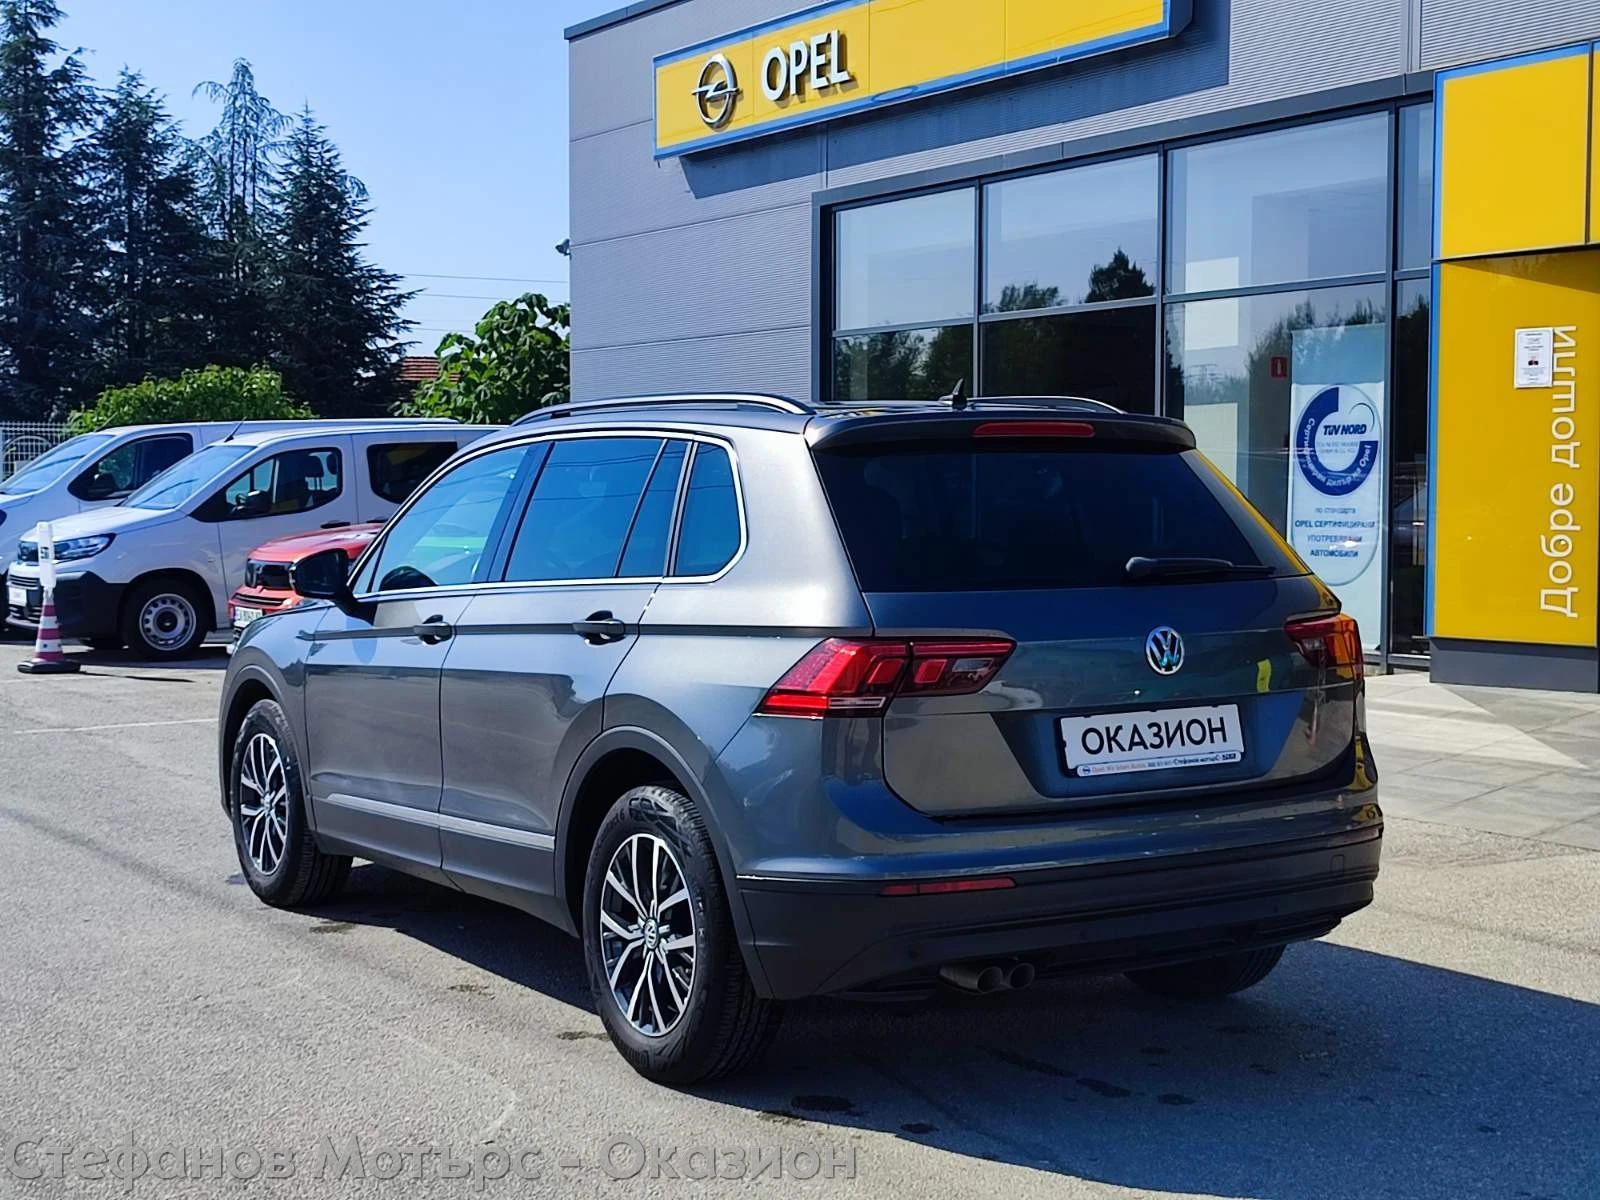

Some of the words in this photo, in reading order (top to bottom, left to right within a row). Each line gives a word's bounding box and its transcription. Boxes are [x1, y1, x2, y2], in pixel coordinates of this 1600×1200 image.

[761, 29, 850, 101] OPEL
[1551, 325, 1581, 468] дошли
[1340, 423, 1367, 435] NORD
[1359, 444, 1373, 468] Opel
[1294, 520, 1313, 528] OPEL
[1540, 483, 1581, 617] Добре
[1081, 716, 1227, 755] ОКАЗИОН
